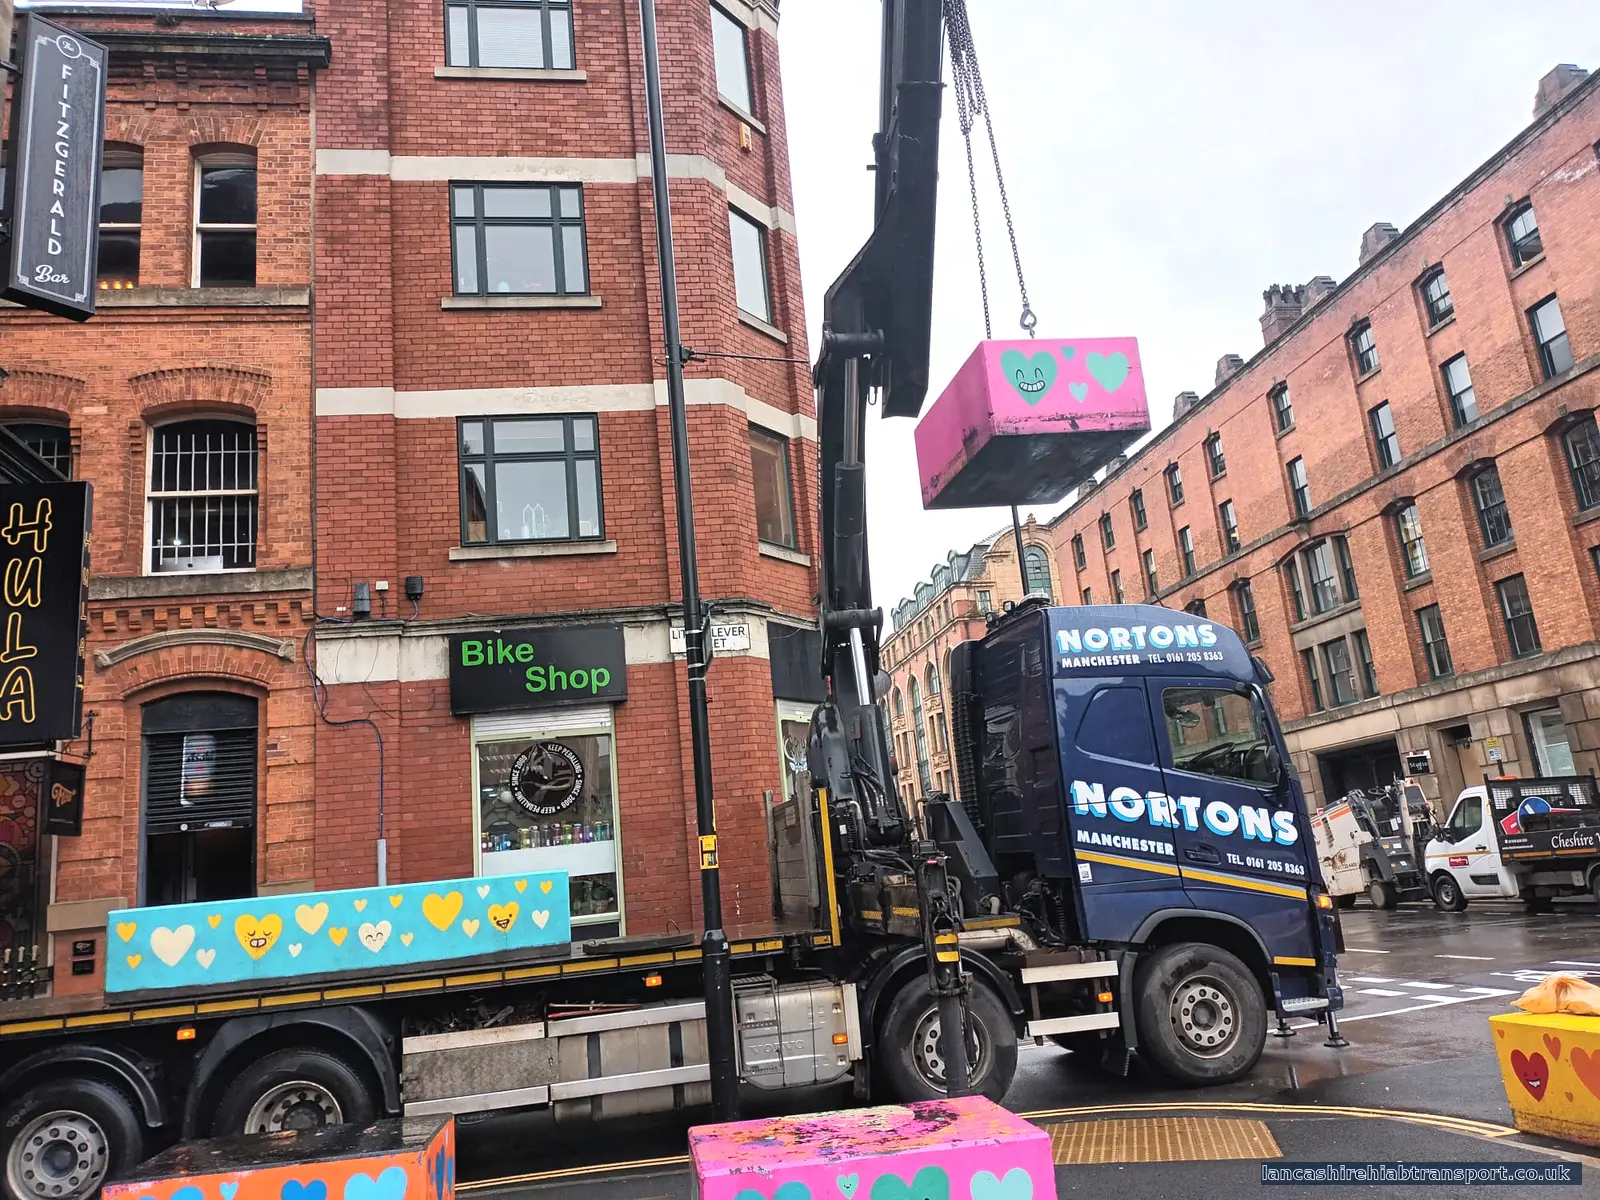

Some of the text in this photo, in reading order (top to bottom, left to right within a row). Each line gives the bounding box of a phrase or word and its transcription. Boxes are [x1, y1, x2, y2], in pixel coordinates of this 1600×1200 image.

[47, 64, 72, 255] FITZGERALD
[34, 264, 70, 284] Bar
[0, 498, 52, 723] HULA
[711, 626, 745, 638] LEVER
[1056, 624, 1217, 654] NORTONS
[461, 638, 534, 666] Bike
[1062, 651, 1223, 668] MANCHESTER TEL. 0161 205 8363
[525, 665, 611, 694] Shop
[512, 754, 528, 786] SINCE 2009
[547, 744, 583, 774] KEEP PEDALLING
[515, 791, 556, 814] KEEP PEDALLING
[560, 780, 583, 808] SINCE 2009
[1070, 780, 1299, 846] NORTONS
[1077, 830, 1175, 857] MANCHESTER
[1551, 831, 1594, 848] Cheshire
[1227, 853, 1305, 876] TEL. 0161 205 8363
